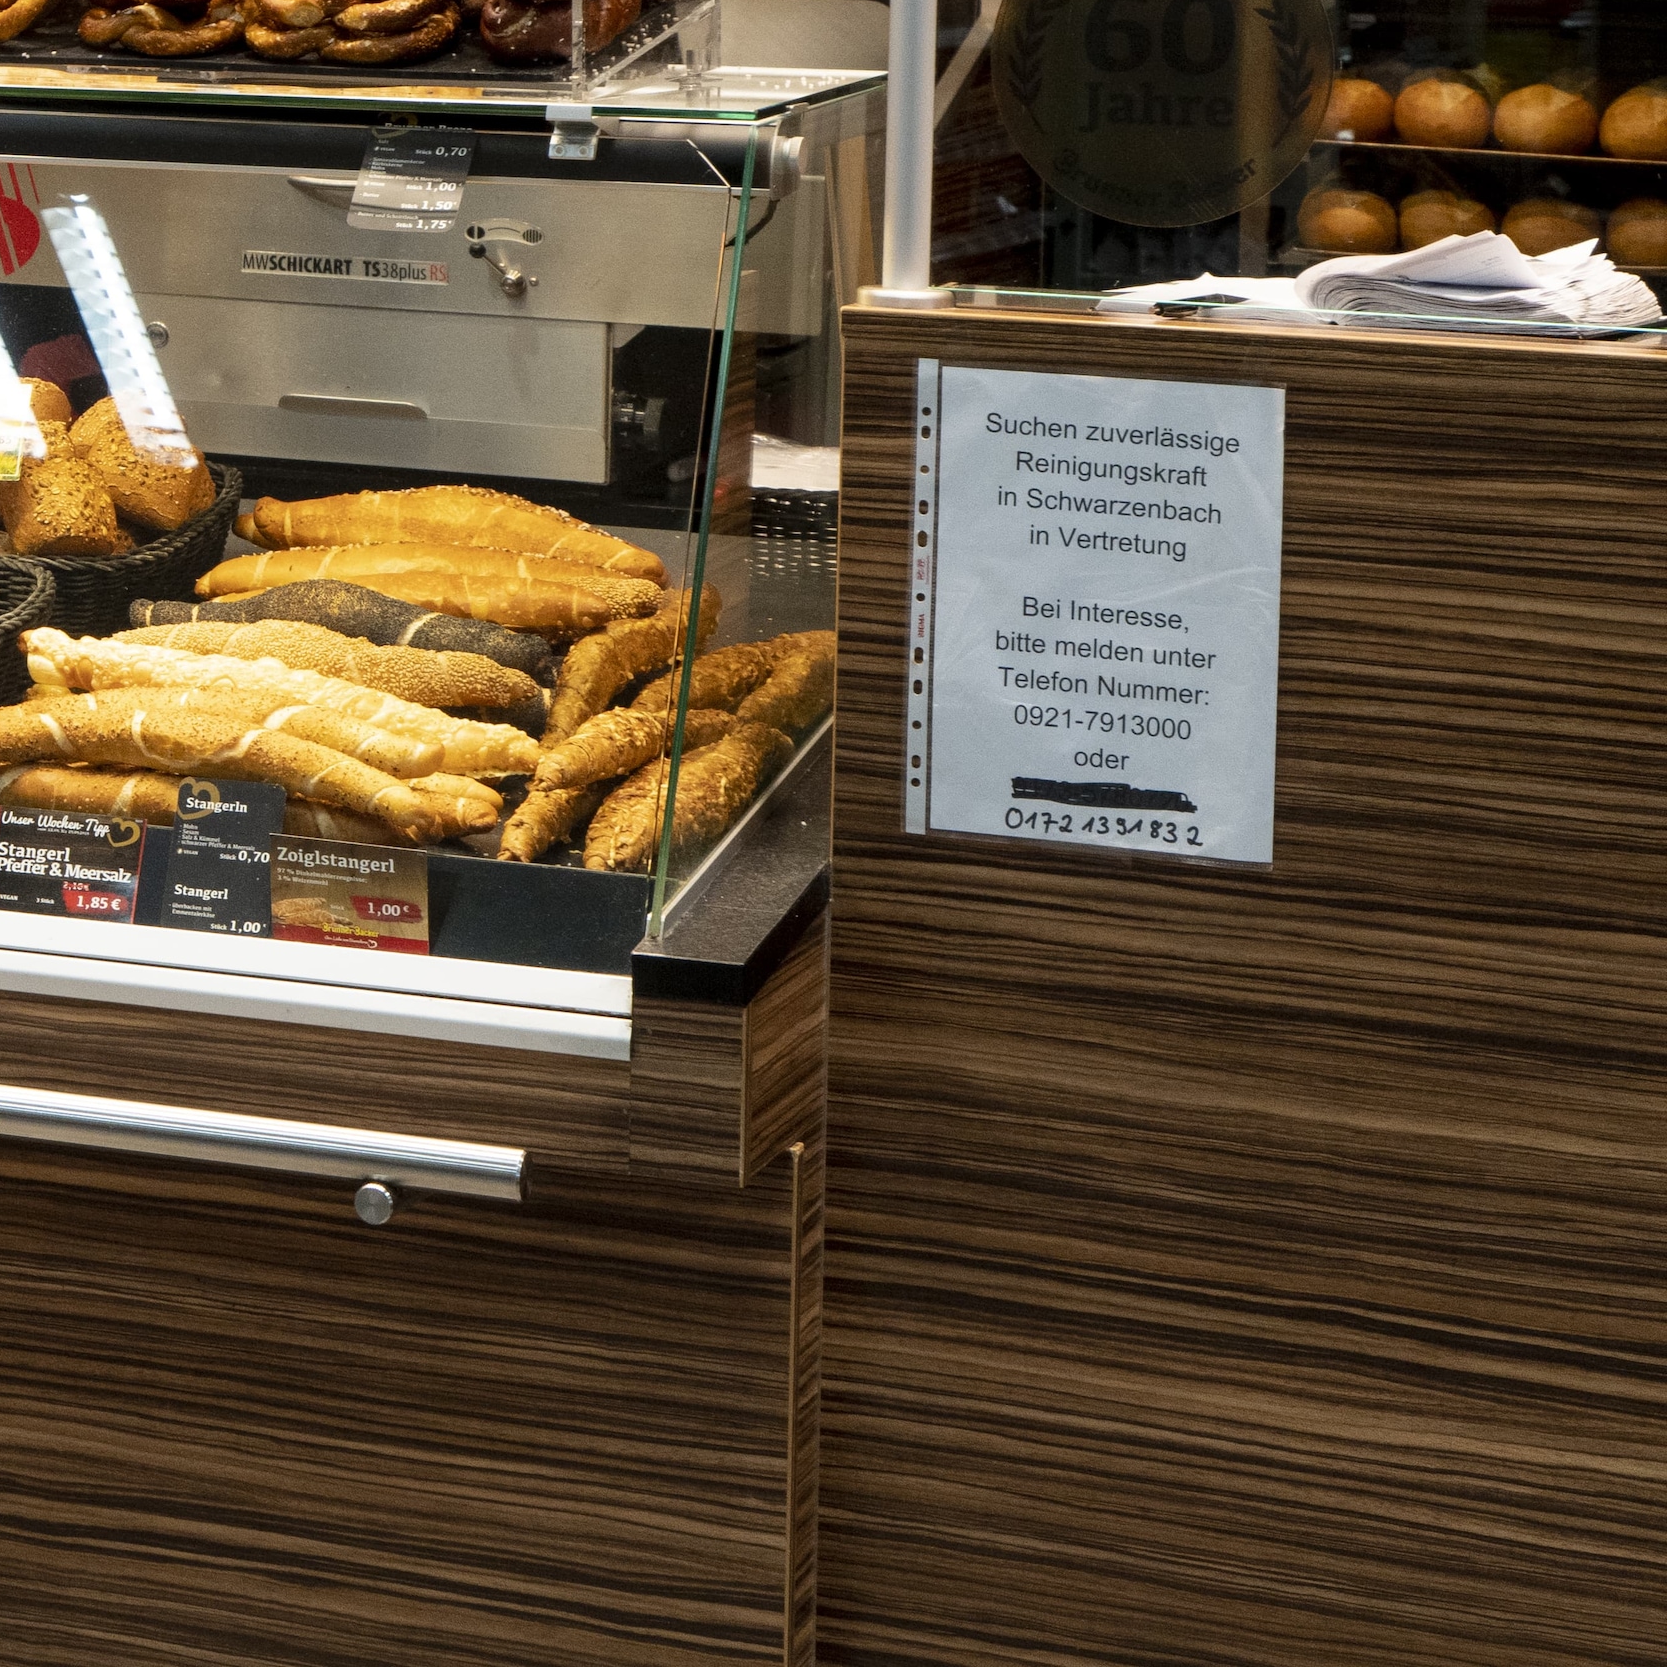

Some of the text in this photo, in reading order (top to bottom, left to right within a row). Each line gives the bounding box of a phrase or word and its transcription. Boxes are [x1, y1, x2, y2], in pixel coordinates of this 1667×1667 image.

[1079, 81, 1234, 134] Jahre
[243, 253, 352, 275] MWSCHICKART
[986, 412, 1240, 456] Suchen zuverlässige
[1016, 451, 1207, 488] Reinigungskraft
[998, 485, 1222, 525] in Schwarzenbach
[1029, 524, 1187, 563] in Vertretung
[1023, 596, 1190, 634] Bei Interesse,
[995, 630, 1216, 670] bitte melden unter
[998, 666, 1210, 707] Telefon Nummer:
[1014, 703, 1191, 741] 0921-7913000
[1073, 748, 1129, 771] oder
[185, 797, 248, 814] Stangerln
[1, 811, 110, 837] Unser Wochen-Tipp
[238, 850, 270, 864] 0,70
[277, 847, 395, 874] Zoiglstangerl
[49, 864, 62, 877] &
[64, 865, 131, 884] Meersalz
[76, 895, 108, 910] 1,85
[174, 884, 228, 900] Stangerl
[368, 902, 400, 917] 1,00
[229, 920, 261, 934] 1,00
